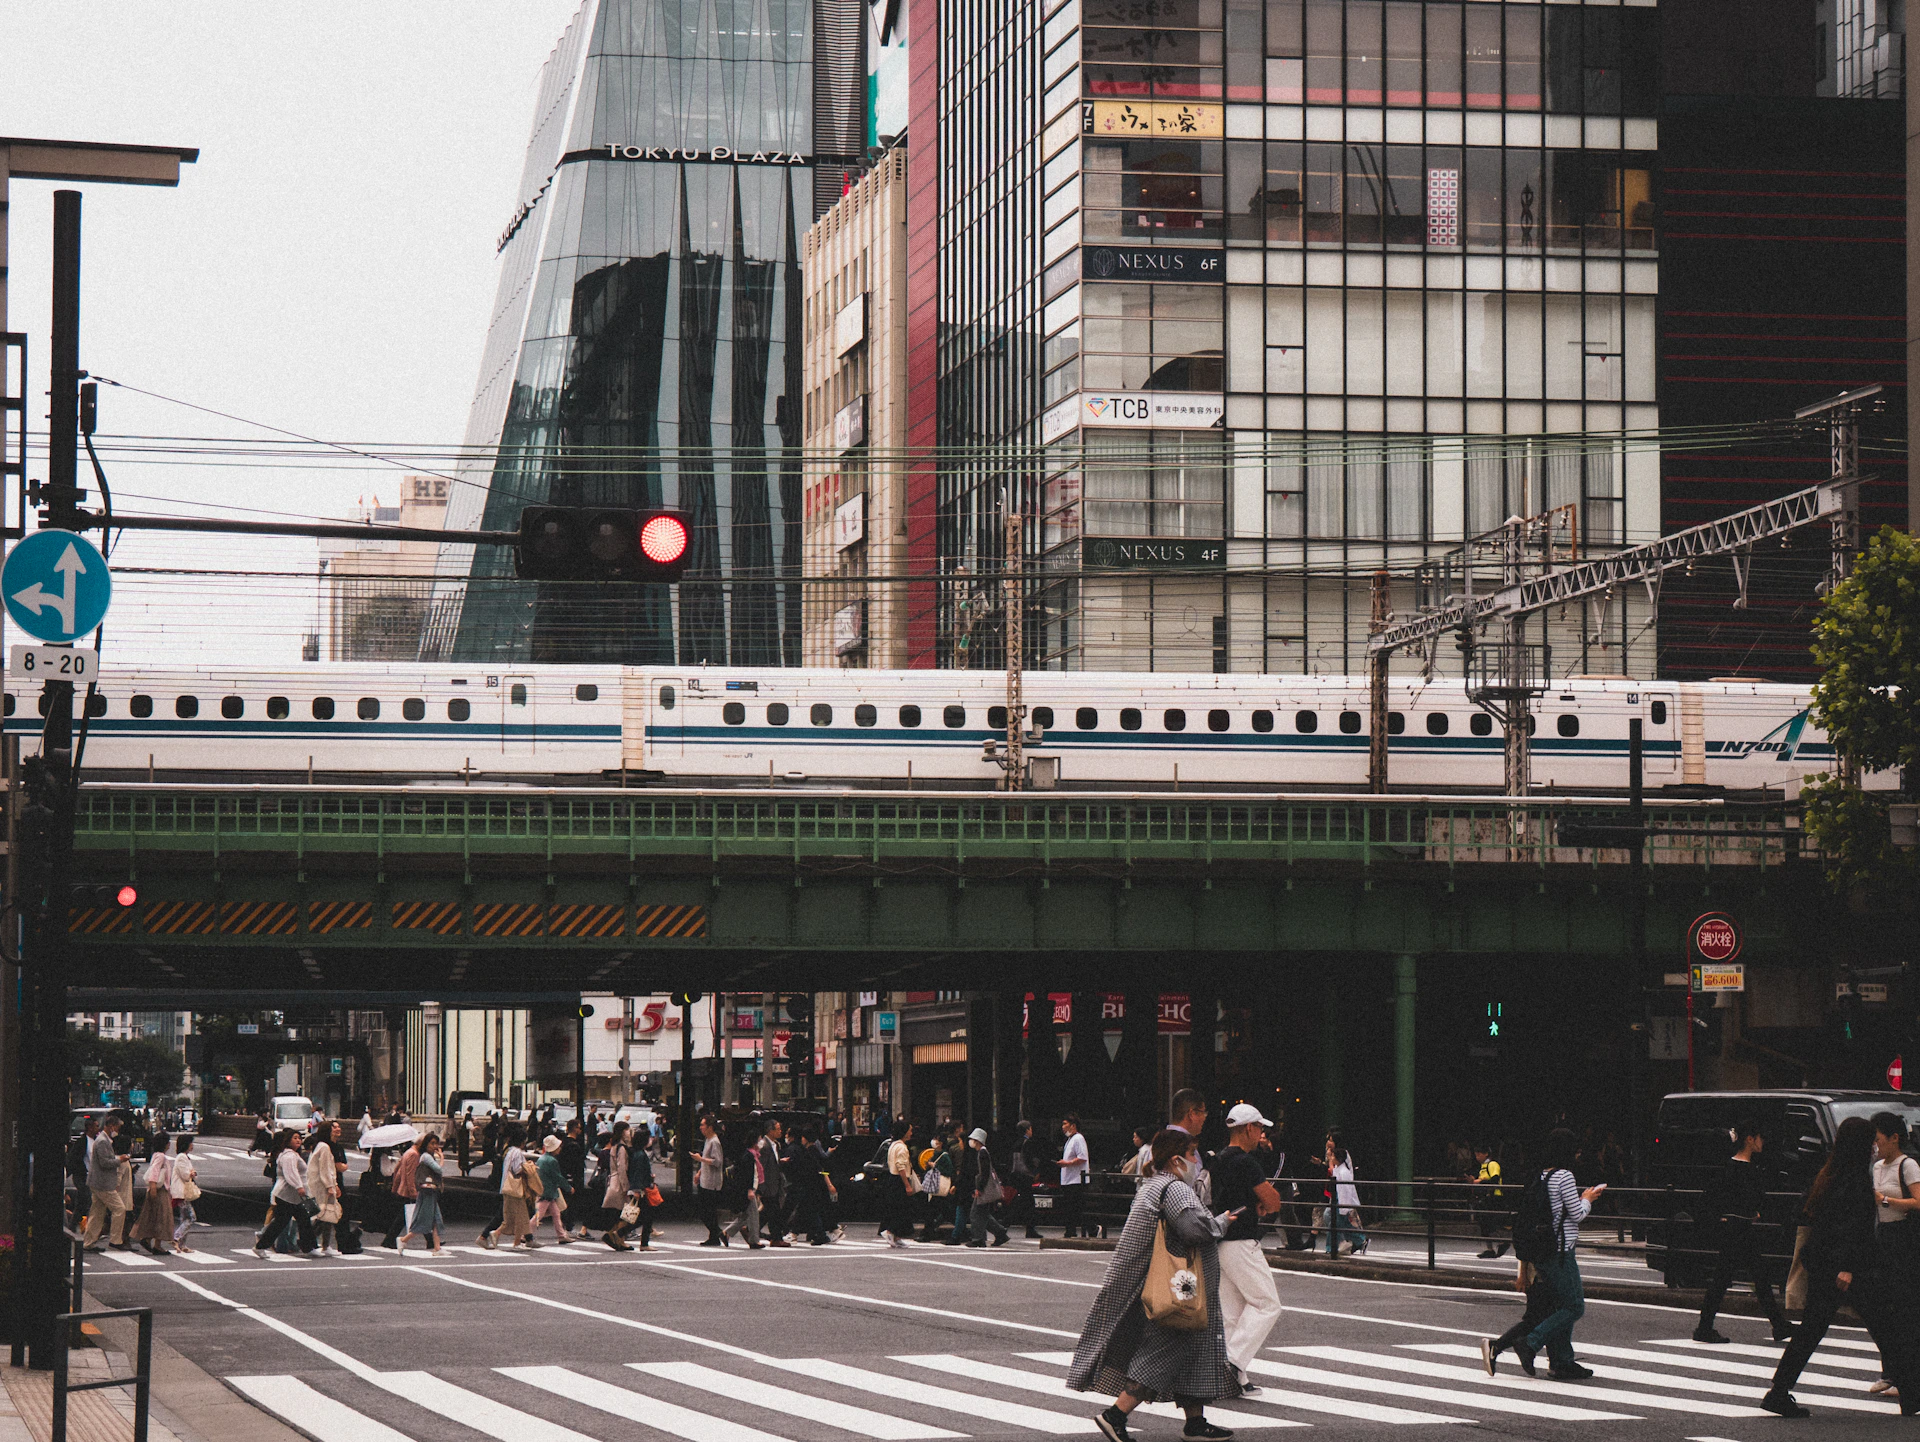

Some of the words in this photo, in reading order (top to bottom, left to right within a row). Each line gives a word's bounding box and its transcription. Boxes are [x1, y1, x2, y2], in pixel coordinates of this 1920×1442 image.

[606, 143, 699, 161] TOKYU
[711, 145, 805, 164] PLAZA
[1119, 253, 1184, 270] NEXUS
[1200, 258, 1218, 270] 6F
[1109, 398, 1149, 419] TCB
[1155, 405, 1221, 415] 東京中央美容外科
[415, 480, 451, 497] HE
[1120, 544, 1185, 561] NEXUS
[1201, 549, 1219, 561] 4F
[487, 676, 498, 687] 15
[688, 679, 699, 690] 14
[1627, 693, 1638, 704] 14
[1724, 740, 1790, 753] N700
[1701, 931, 1732, 947] 消火栓
